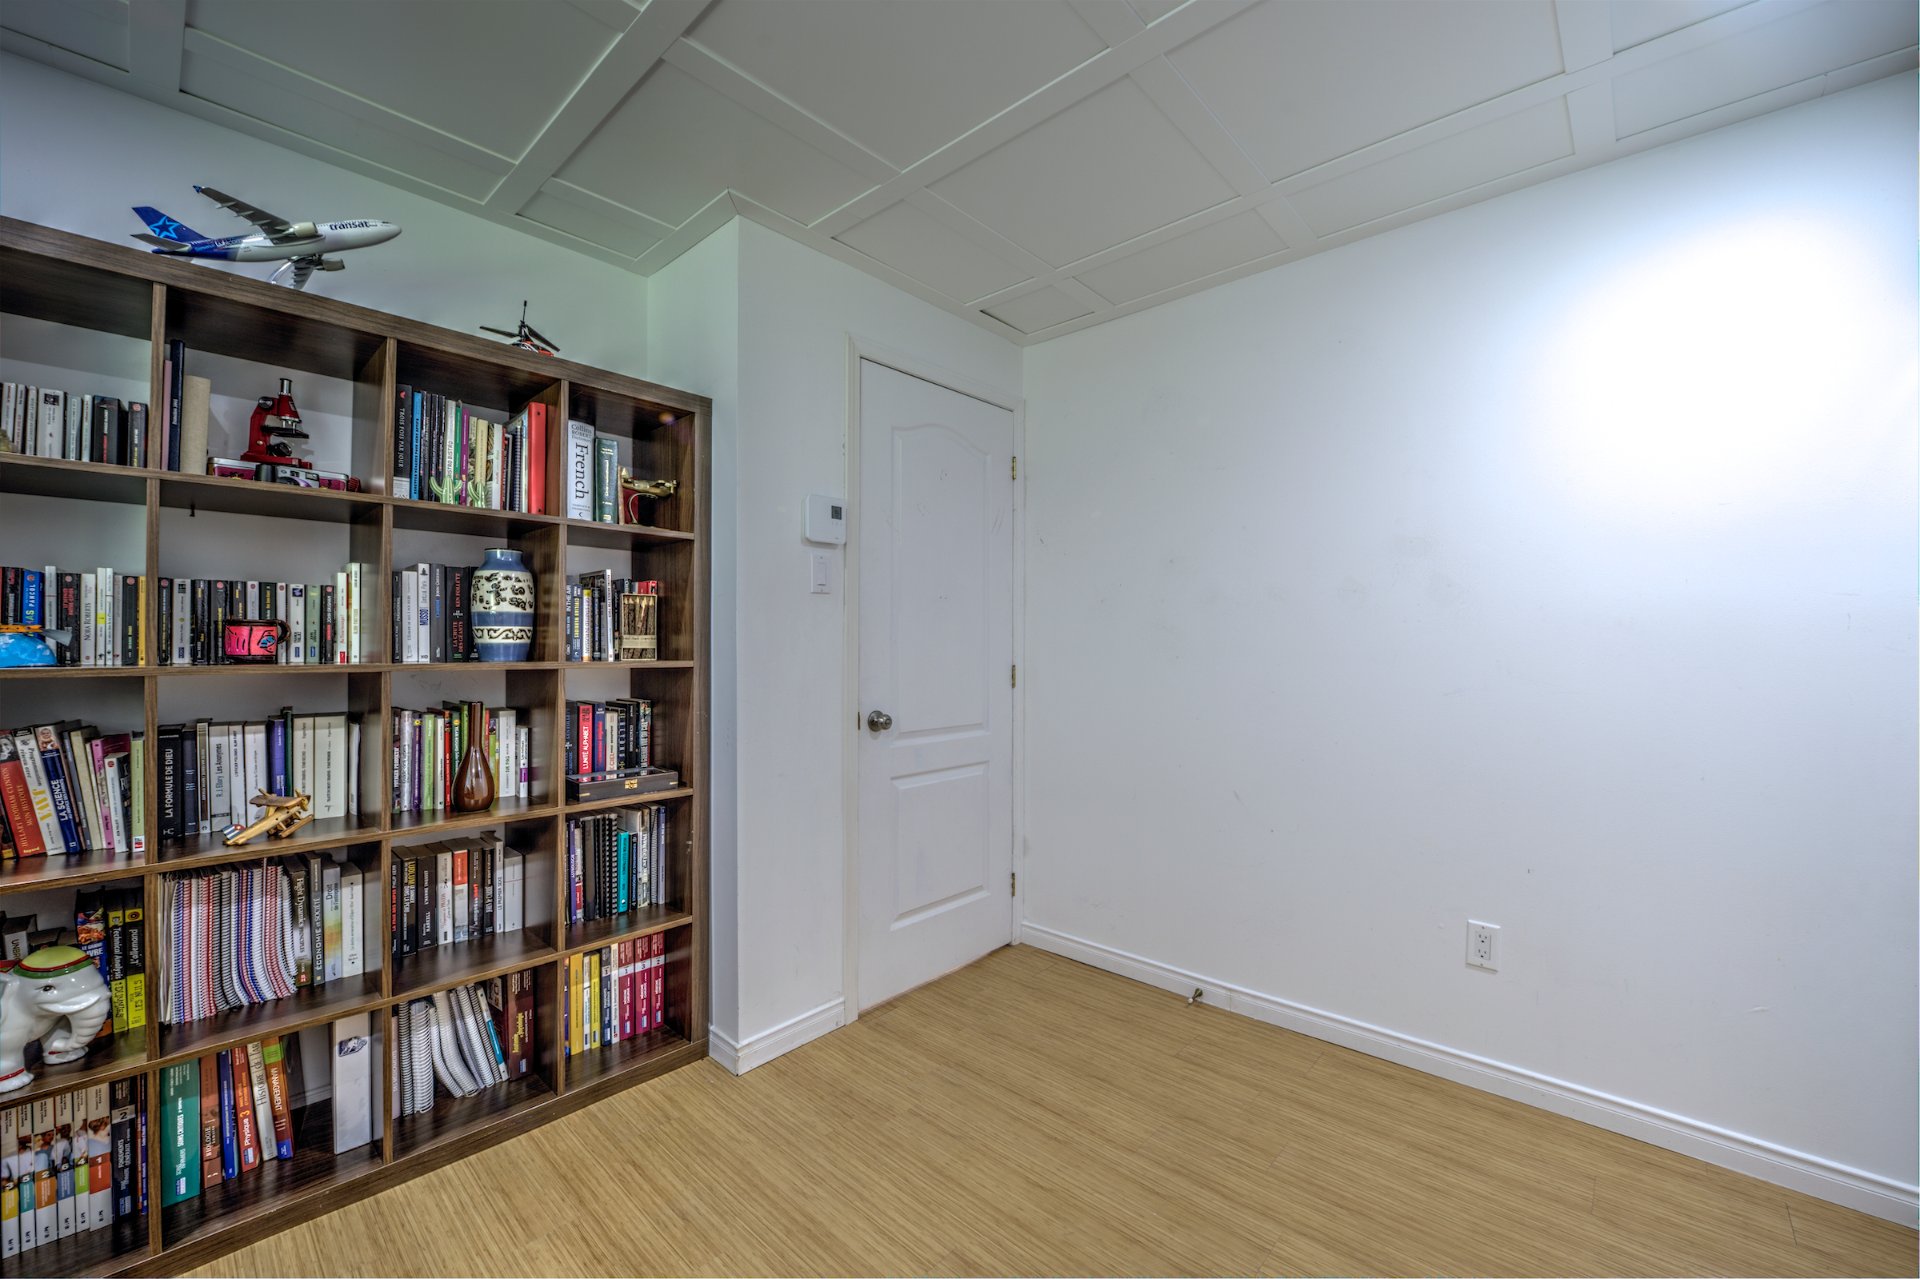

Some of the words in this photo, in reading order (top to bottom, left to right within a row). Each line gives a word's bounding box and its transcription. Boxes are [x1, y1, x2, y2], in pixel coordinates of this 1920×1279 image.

[329, 220, 370, 232] transat
[571, 424, 592, 434] Collins
[575, 443, 589, 500] French
[28, 584, 36, 607] PANCOL
[419, 609, 429, 626] MUSSO
[165, 748, 173, 765] DIEU
[215, 743, 223, 765] Anonymes
[28, 747, 44, 786] Programmation
[165, 766, 173, 775] DE
[3, 767, 15, 794] CLINTON
[165, 775, 173, 807] FORMULE
[17, 784, 31, 811] HISTOIRE
[31, 788, 53, 822] JAVA
[50, 779, 64, 809] SCIENCE
[10, 795, 21, 820] RODHAM
[24, 812, 34, 826] MON
[58, 810, 68, 821] LA
[165, 808, 173, 818] LA
[17, 822, 28, 847] HILLARY
[407, 861, 416, 885] LUDLUM
[294, 878, 305, 896] Flight
[326, 884, 334, 900] Droit
[295, 896, 306, 927] Dynamics
[312, 897, 321, 921] SOCIÉTÉ
[86, 946, 104, 958] IVRE
[112, 927, 122, 956] Technical
[128, 929, 139, 966] L'allemand
[314, 928, 322, 970] ÉCONOMIE
[112, 957, 123, 980] Analysis
[114, 983, 123, 1018] DUMMIES
[135, 979, 143, 998] NULS
[270, 1067, 282, 1111] MANAGEMENT
[119, 1112, 127, 1120] 2
[177, 1134, 185, 1147] SOINS
[204, 1126, 212, 1157] BIOLOGIE
[243, 1118, 253, 1146] Physique
